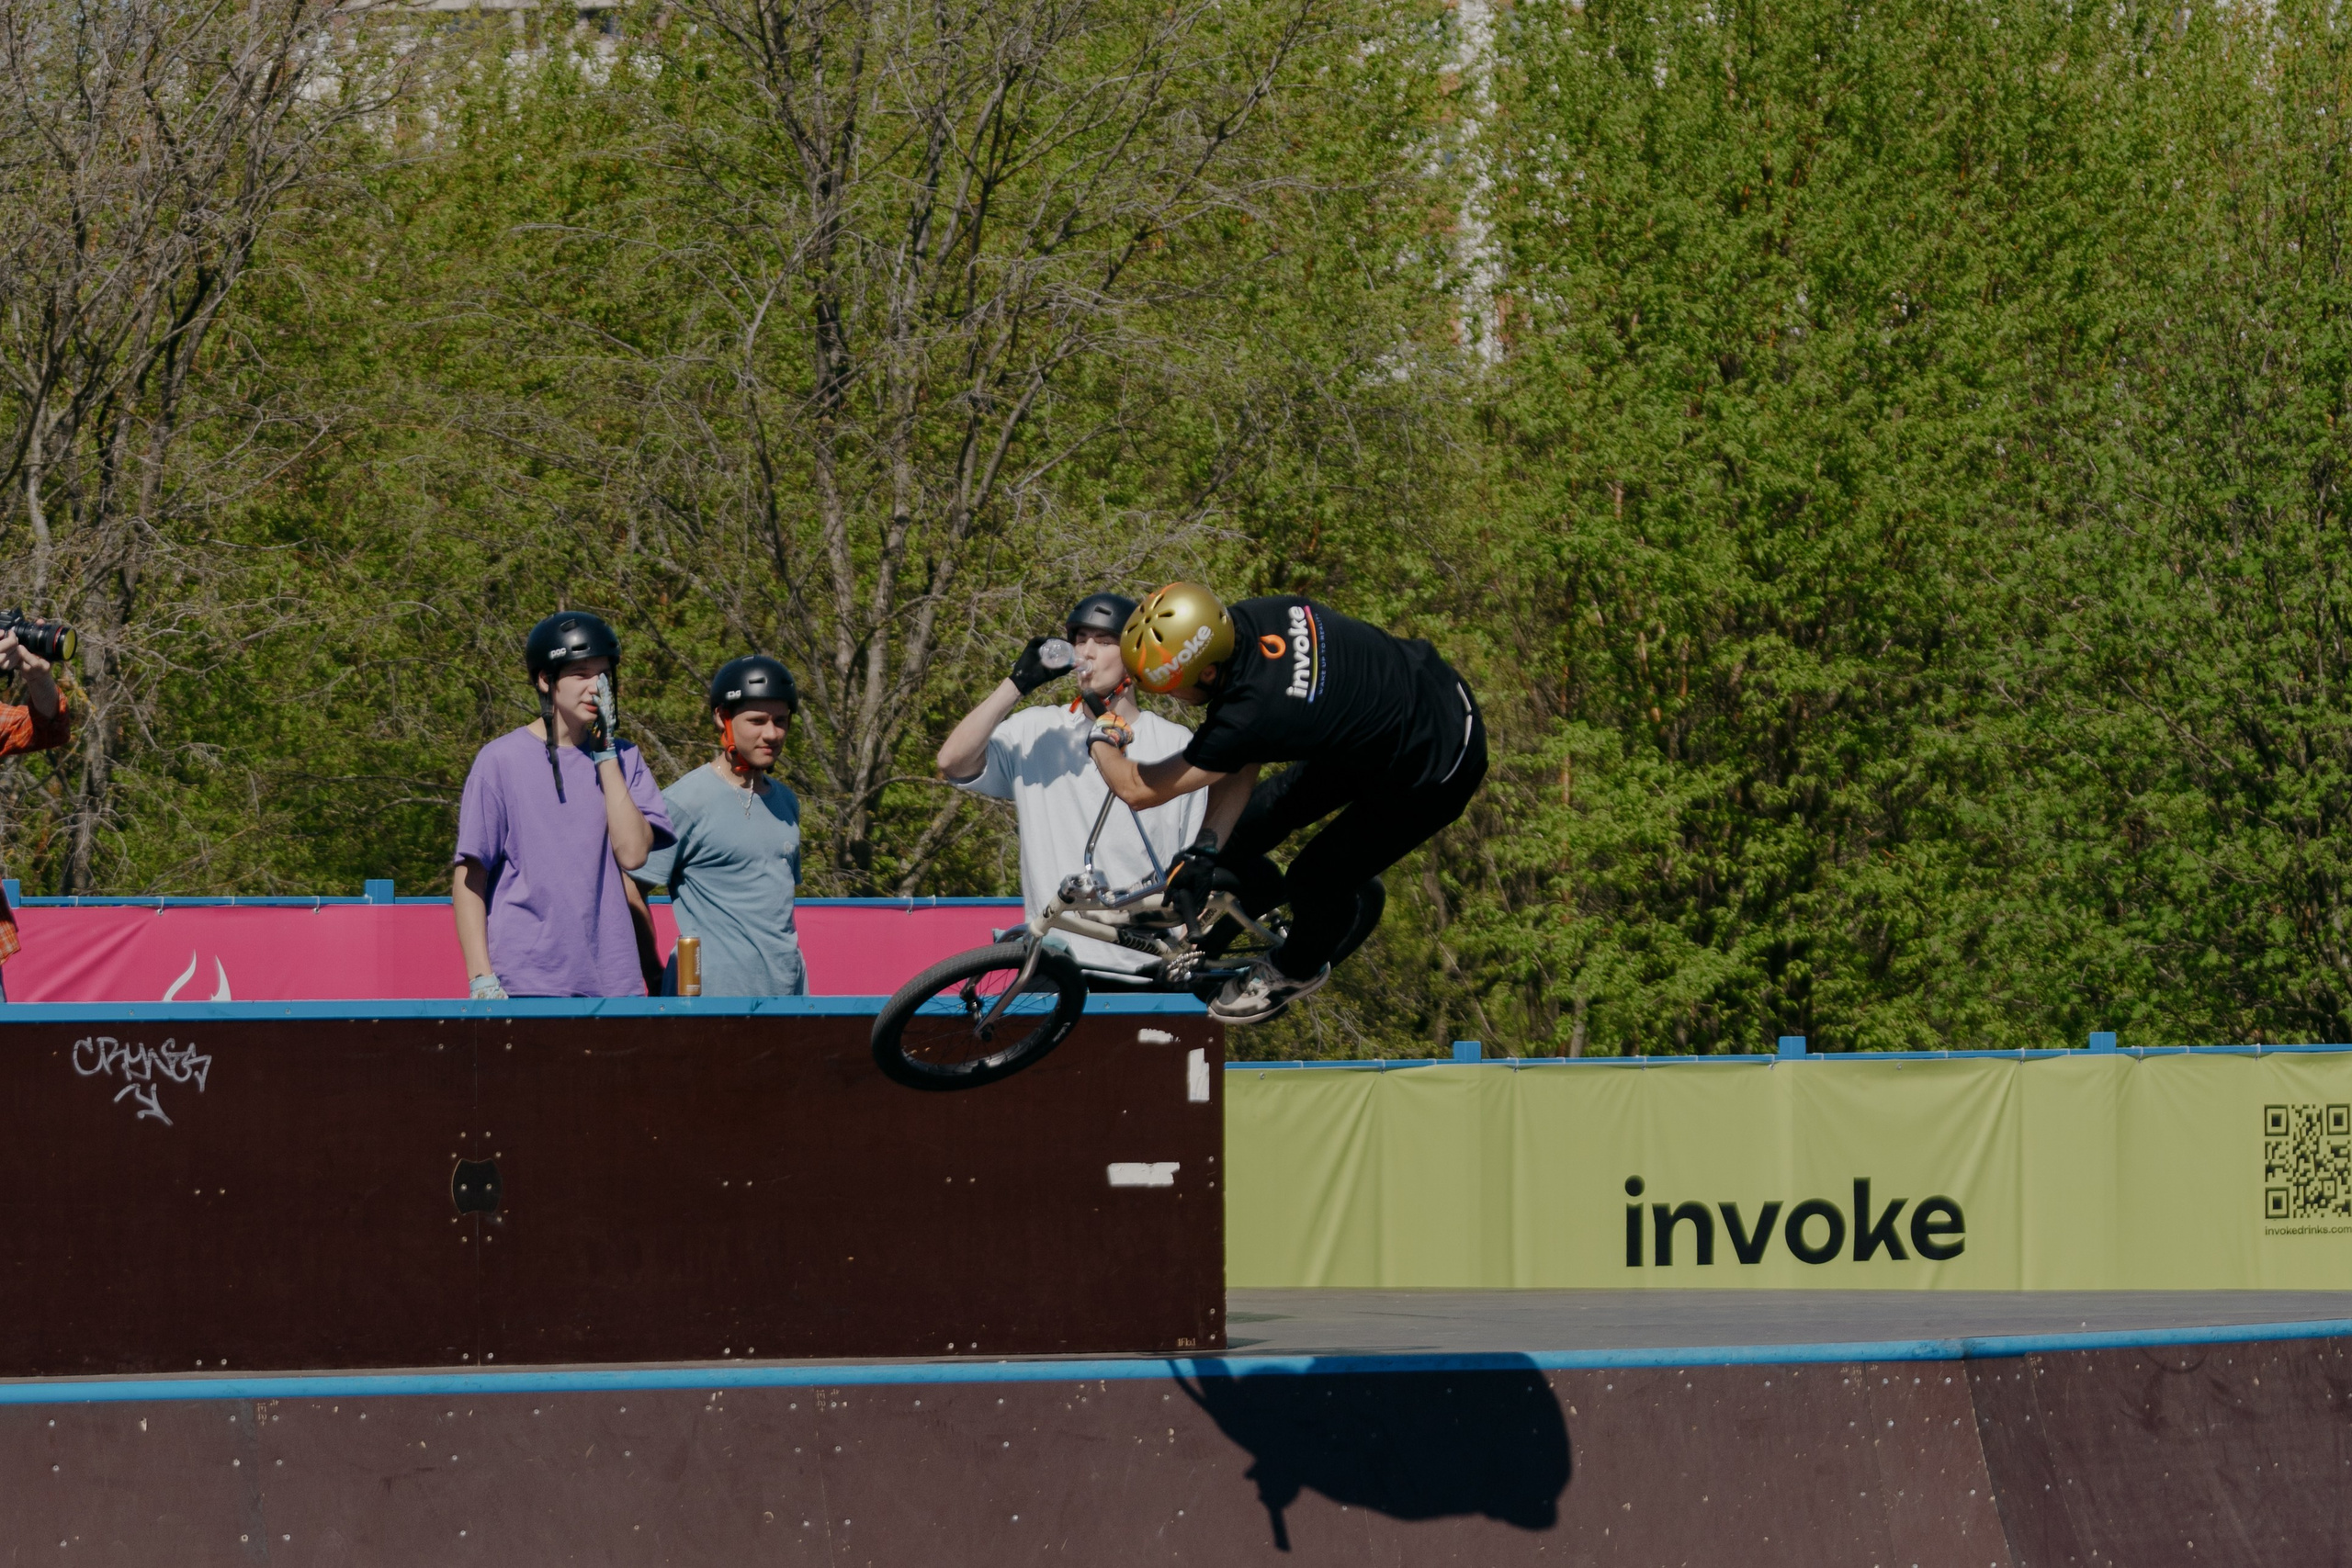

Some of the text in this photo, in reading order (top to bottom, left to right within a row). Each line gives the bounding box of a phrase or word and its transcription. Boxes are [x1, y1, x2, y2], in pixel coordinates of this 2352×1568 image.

[1144, 625, 1212, 682] invoke
[1285, 605, 1310, 698] invoke
[1624, 1175, 1966, 1268] invoke
[2265, 1224, 2352, 1235] invokedrinks.com
